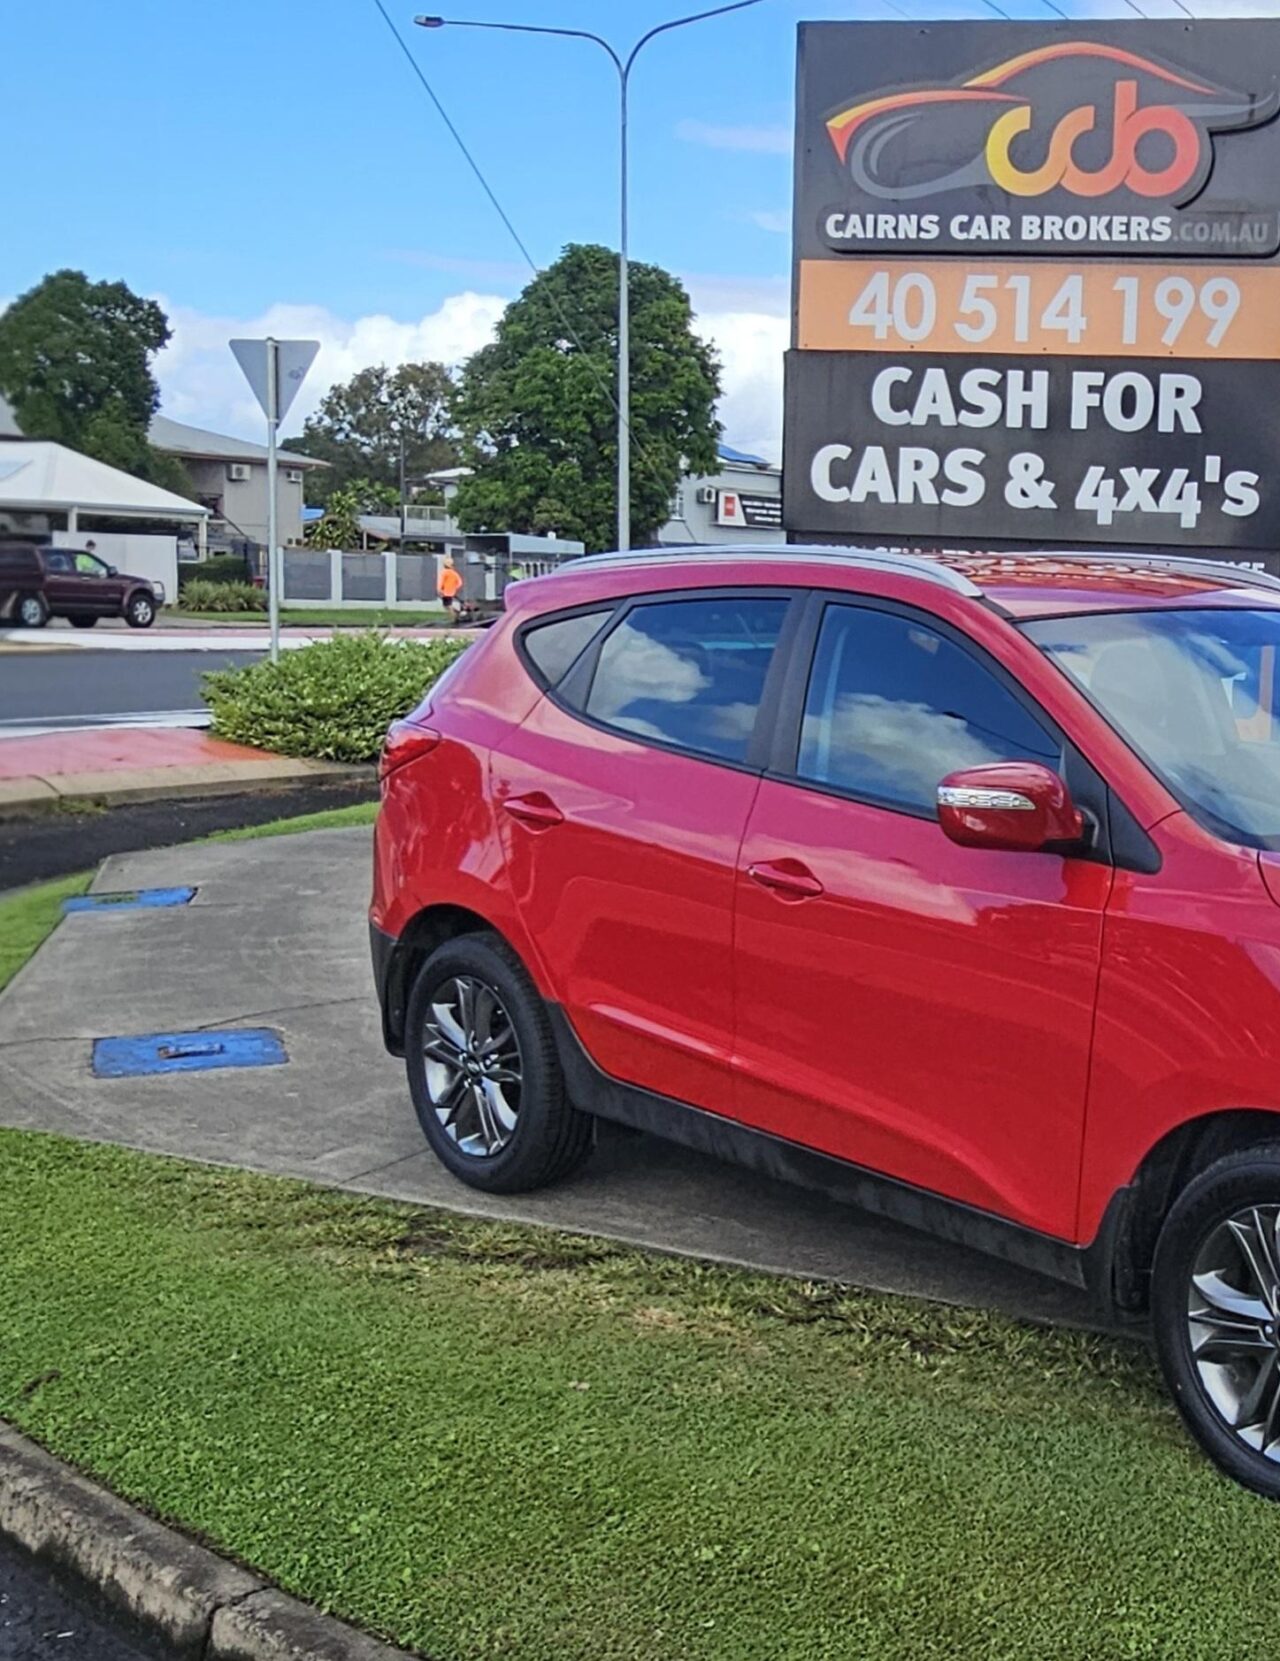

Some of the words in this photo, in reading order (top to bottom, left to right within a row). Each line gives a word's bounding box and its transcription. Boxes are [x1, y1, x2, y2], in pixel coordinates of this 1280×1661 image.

[825, 213, 940, 240] CAIRNS
[950, 214, 1011, 241] CAR
[848, 271, 937, 342] 40
[953, 273, 1087, 344] 514
[1113, 275, 1241, 348] 199
[870, 366, 1050, 430] CASH
[1070, 370, 1203, 434] FOR
[810, 443, 986, 507] CARS
[1004, 451, 1058, 511] &
